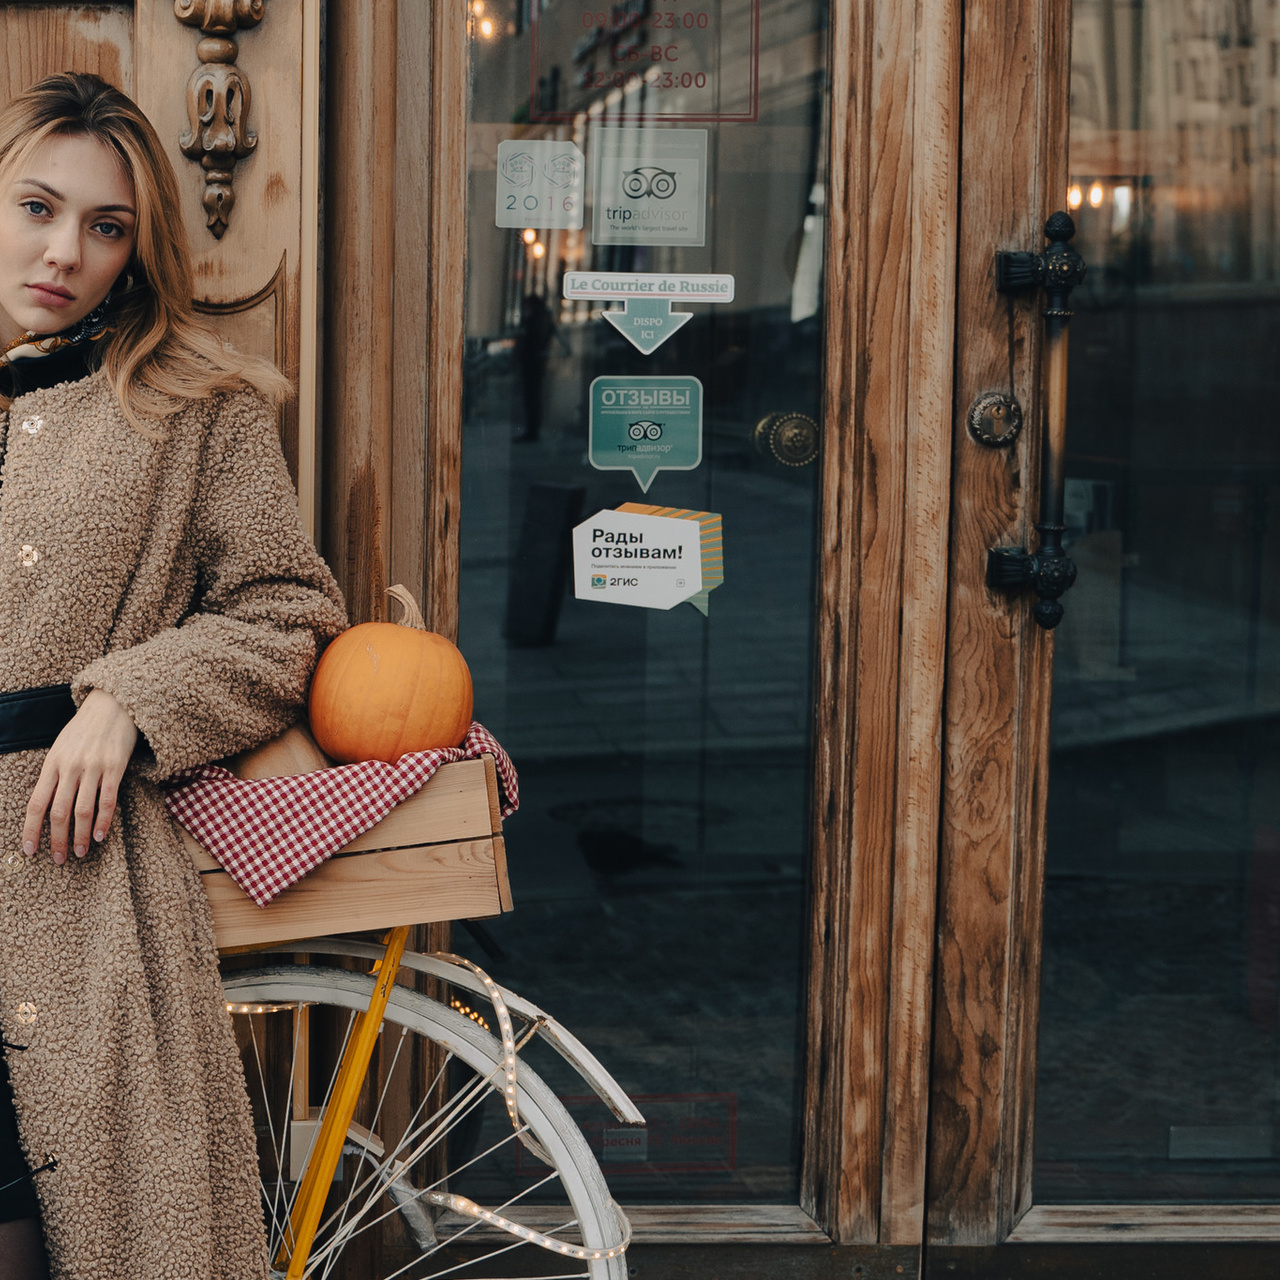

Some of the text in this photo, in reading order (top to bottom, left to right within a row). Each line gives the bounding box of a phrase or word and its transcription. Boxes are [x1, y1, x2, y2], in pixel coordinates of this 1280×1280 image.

[506, 194, 574, 211] 2016
[606, 206, 688, 223] tripadvisor
[642, 224, 661, 232] largest
[570, 279, 728, 293] Le Courrier de Russie
[633, 317, 663, 326] DISPO
[641, 330, 654, 339] ICI
[601, 390, 690, 405] ОТЗЫВЫ
[592, 528, 643, 545] Рады
[591, 545, 683, 559] отзывам!
[610, 577, 638, 586] 2ГИС
